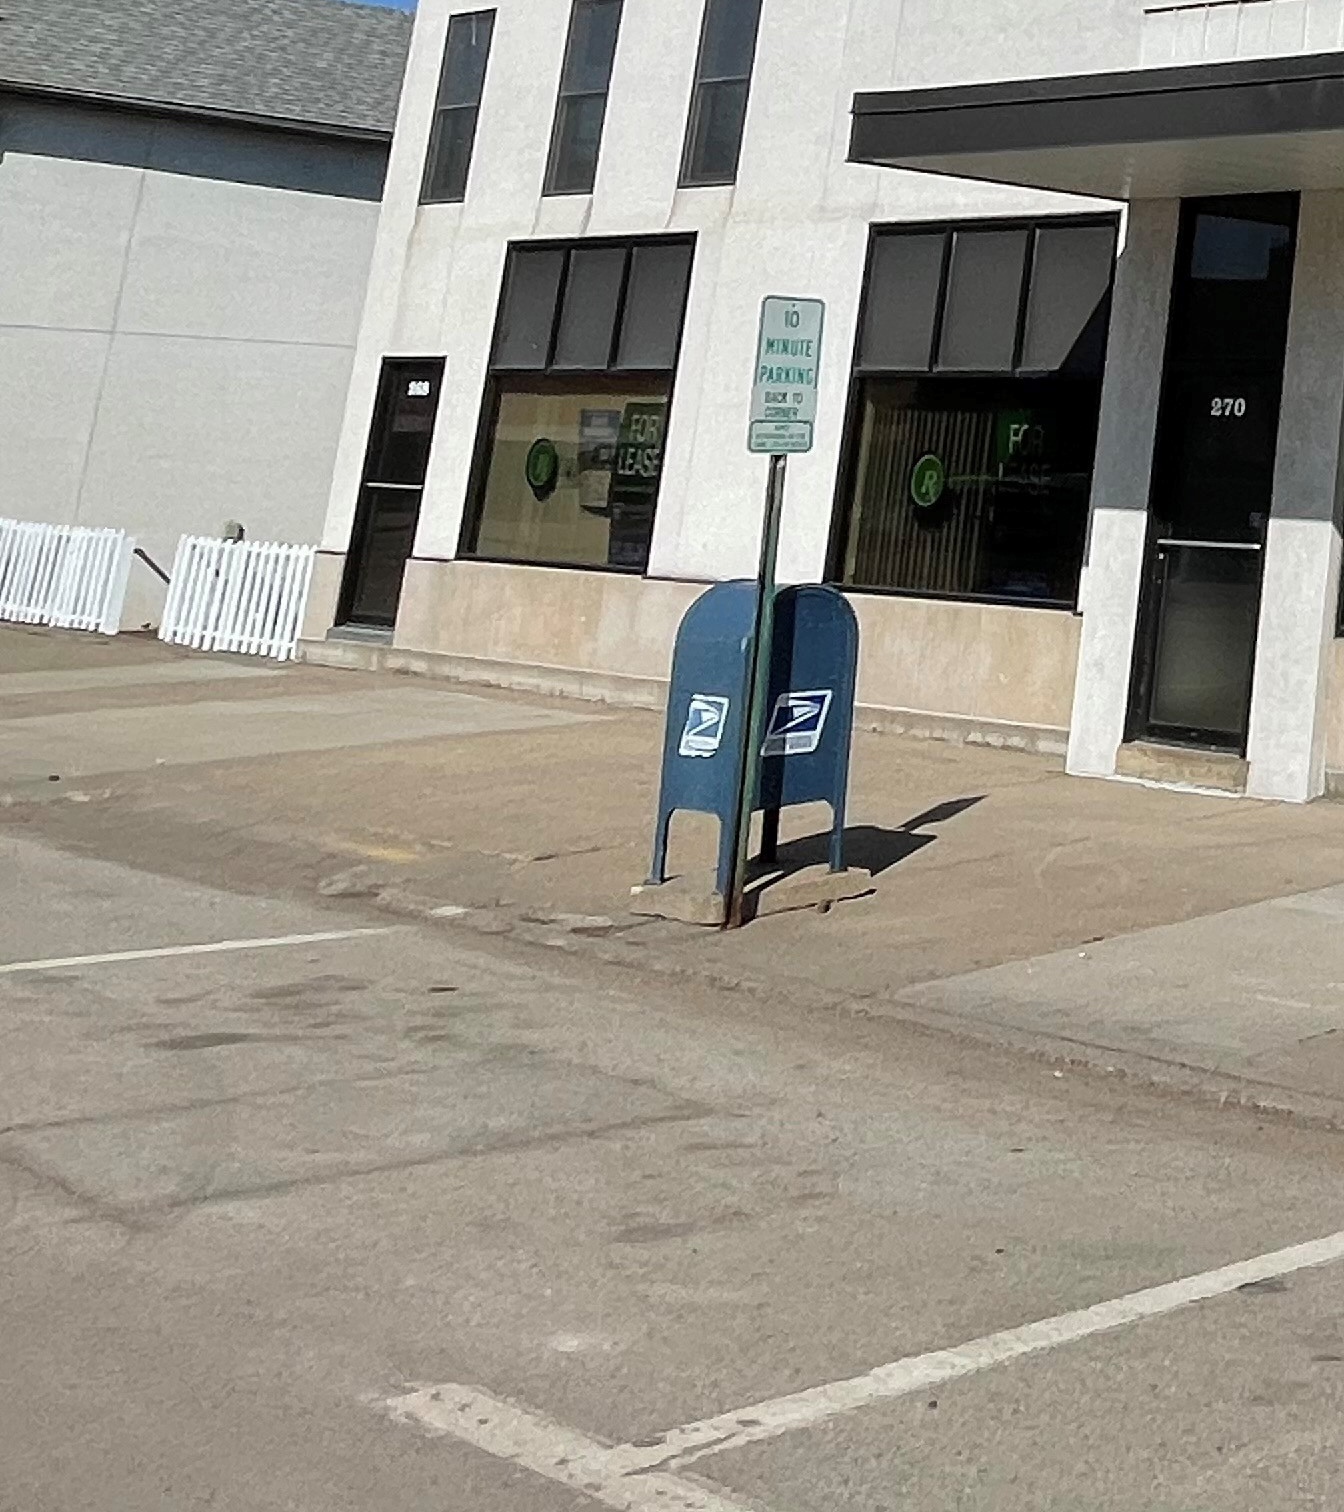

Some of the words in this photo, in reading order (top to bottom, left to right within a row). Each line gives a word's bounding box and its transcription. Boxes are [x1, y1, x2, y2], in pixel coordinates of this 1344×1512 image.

[784, 310, 800, 328] 10
[765, 337, 814, 358] MINUTE
[759, 365, 814, 385] PARKING
[1210, 397, 1246, 417] 270
[629, 414, 661, 442] FOR
[616, 447, 662, 478] LEASE
